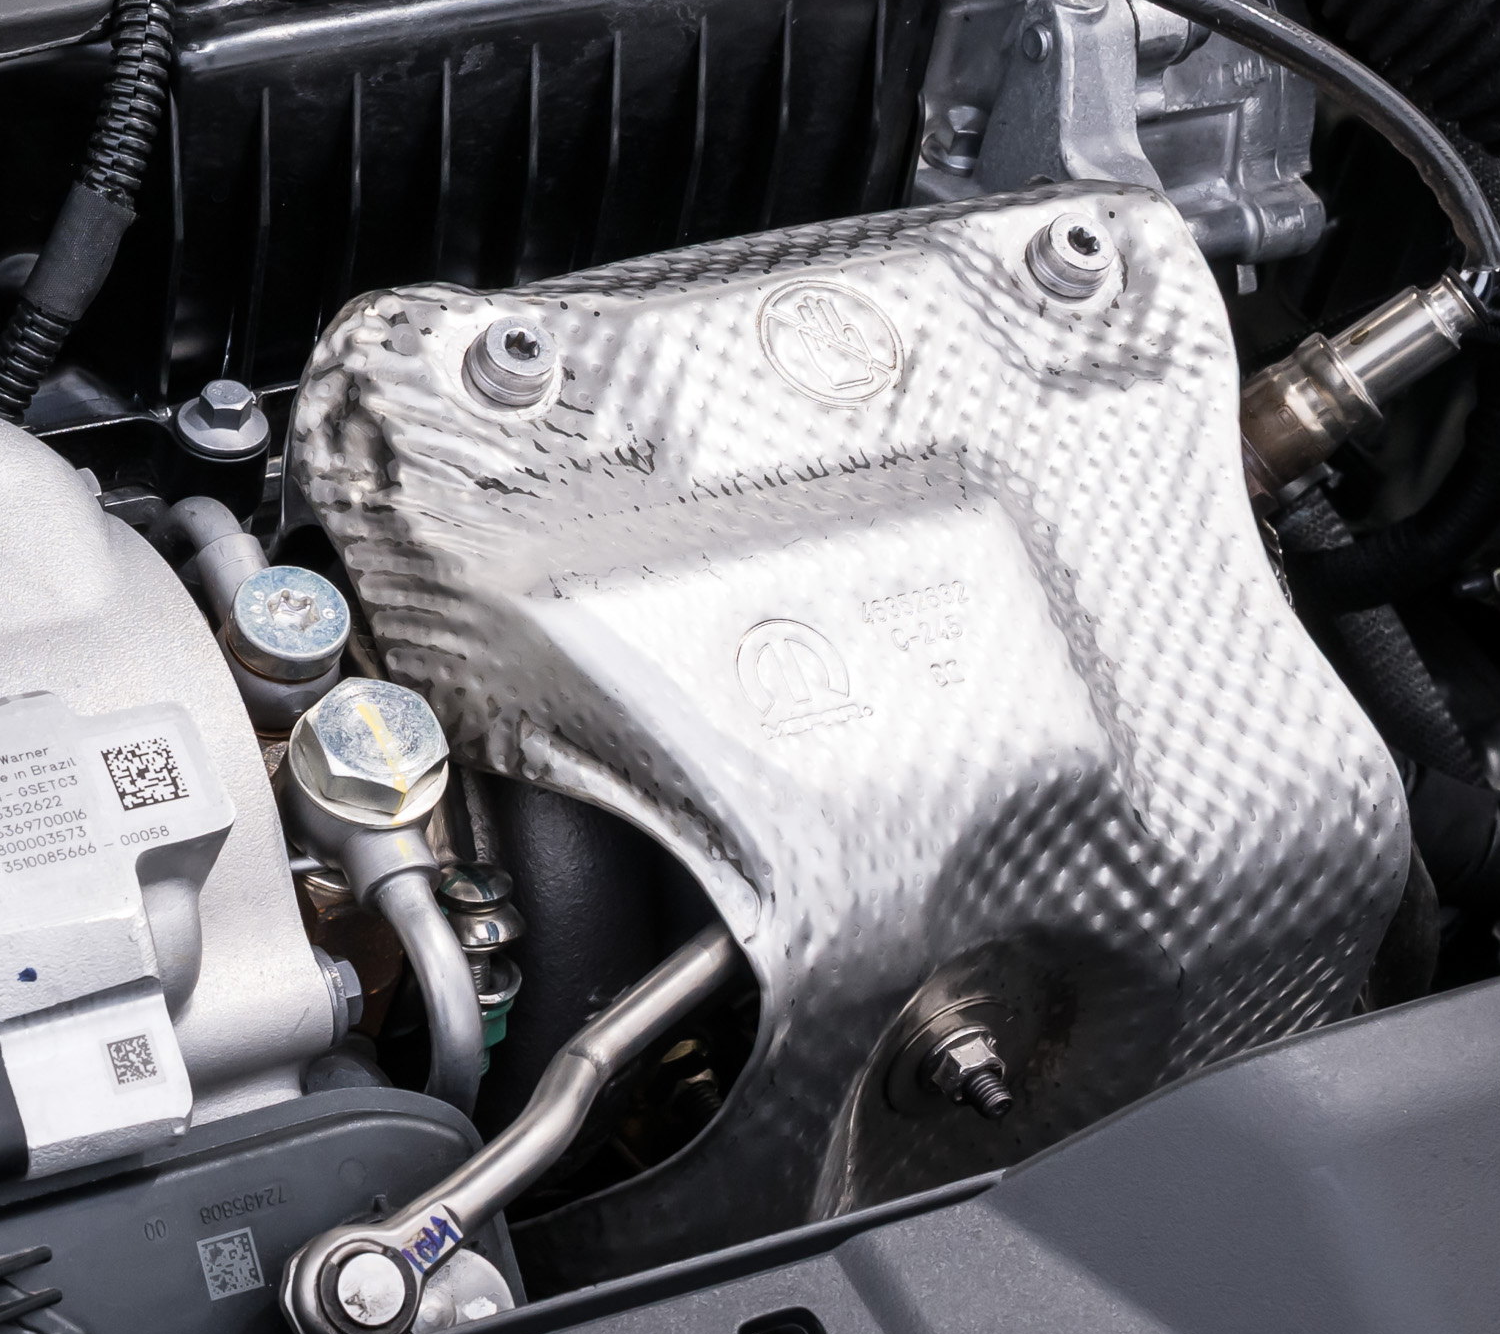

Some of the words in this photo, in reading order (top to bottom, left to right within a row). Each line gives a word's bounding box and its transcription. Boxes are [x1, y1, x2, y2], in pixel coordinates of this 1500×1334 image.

[14, 768, 28, 780] in
[31, 757, 77, 776] Brazil
[18, 775, 79, 797] GSETC3
[2, 842, 98, 873] 3510085666
[120, 825, 171, 846] 00058
